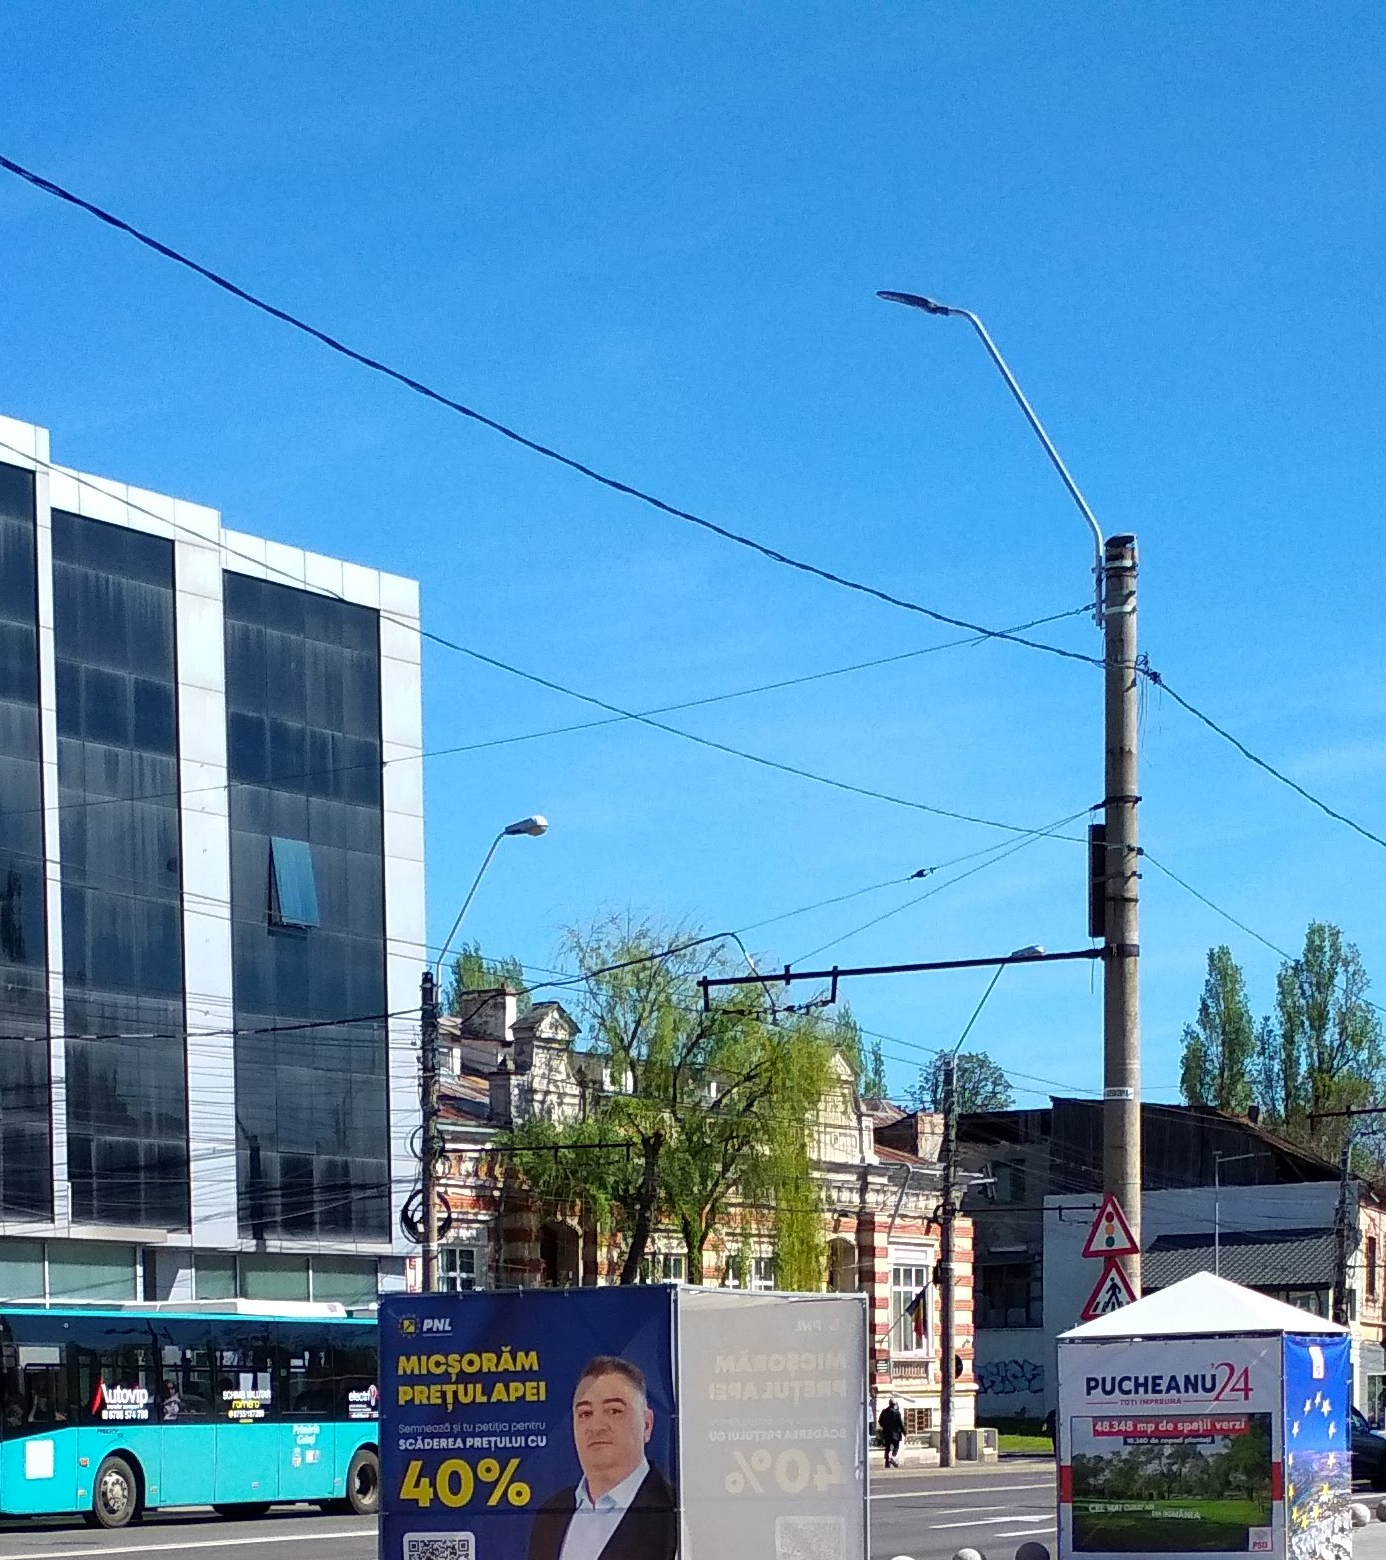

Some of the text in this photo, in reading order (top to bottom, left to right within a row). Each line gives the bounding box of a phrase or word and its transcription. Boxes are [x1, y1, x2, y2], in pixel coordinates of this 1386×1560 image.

[422, 1318, 452, 1332] PNL
[397, 1345, 539, 1383] MICȘORĂM
[1085, 1373, 1217, 1397] PUCHEANU
[398, 1381, 546, 1413] PREȚUL APEI
[398, 1421, 546, 1434] Semnează și tu petiția pentru
[1136, 1423, 1155, 1434] mp
[1158, 1419, 1173, 1431] de
[1177, 1419, 1211, 1434] spații
[1214, 1418, 1246, 1430] verzi
[398, 1435, 547, 1452] SCĂDEREA PREȚULUI CU
[399, 1458, 531, 1508] 40%
